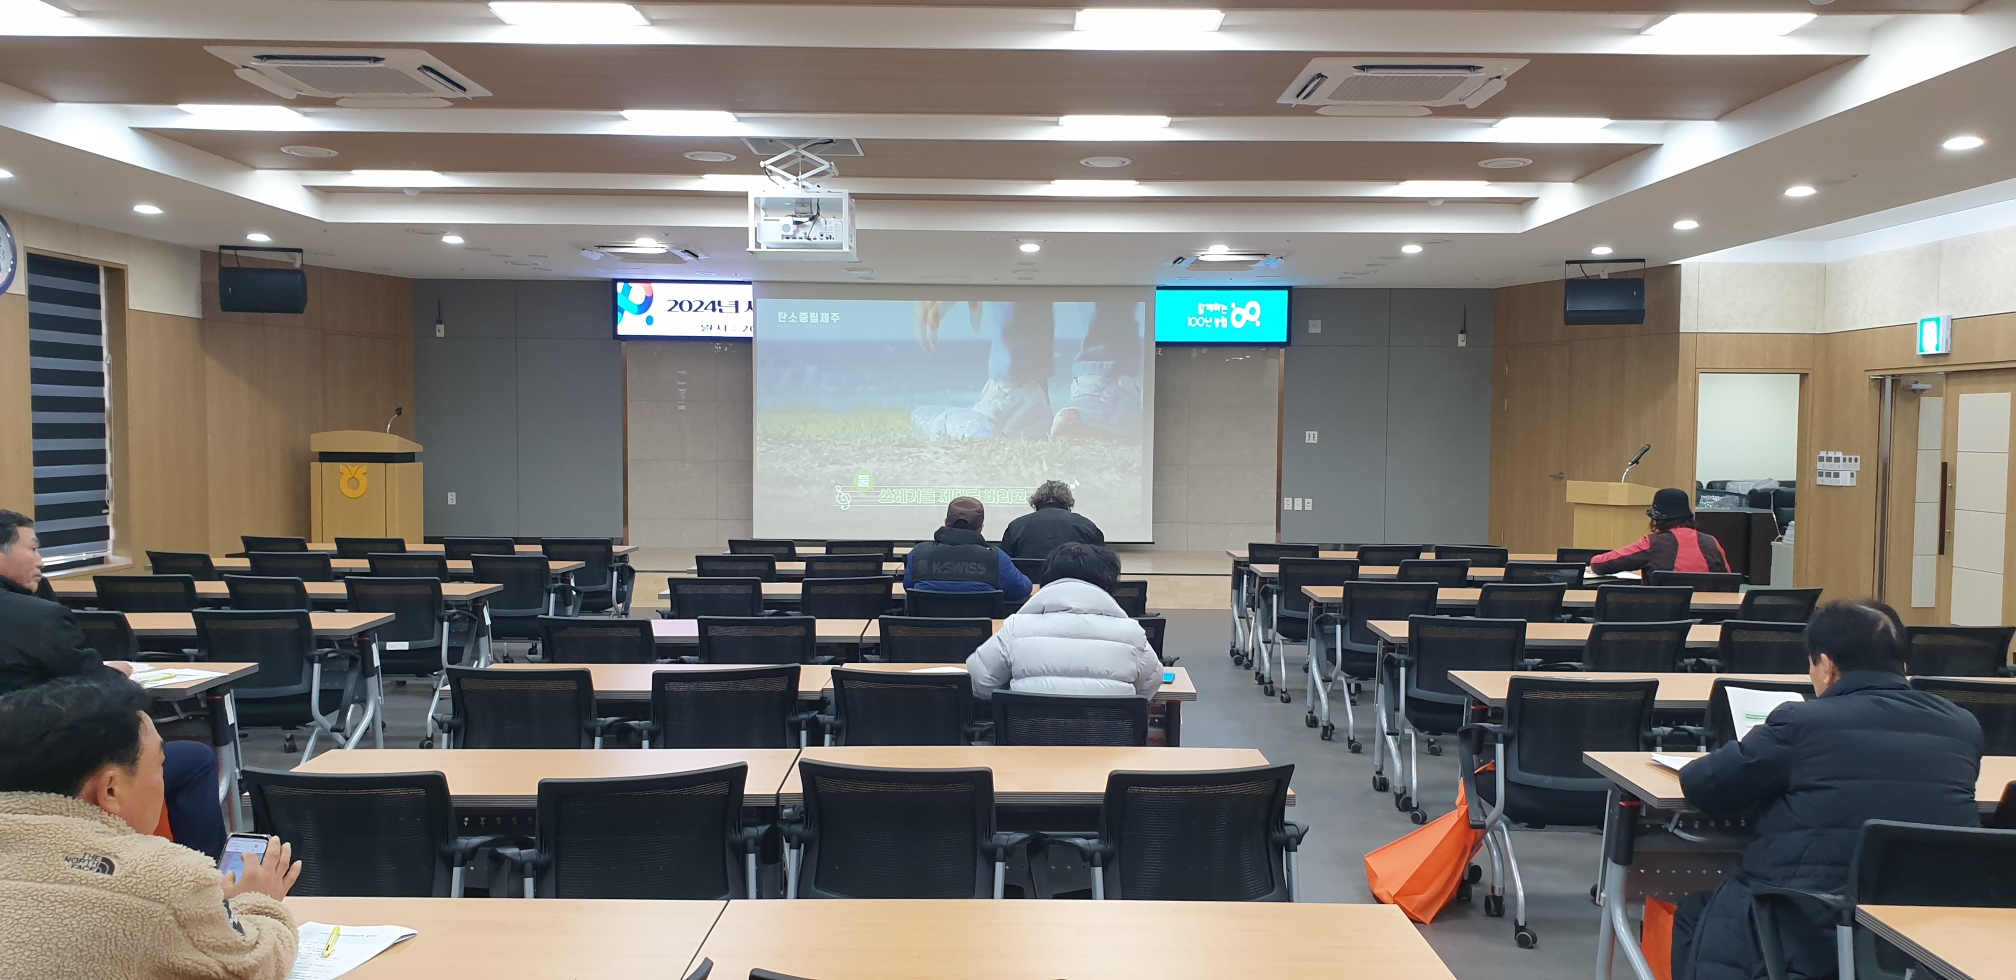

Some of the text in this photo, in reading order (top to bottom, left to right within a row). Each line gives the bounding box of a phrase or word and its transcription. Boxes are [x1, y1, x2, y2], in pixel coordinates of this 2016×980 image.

[666, 299, 739, 314] 2024년
[878, 488, 935, 504] 쓰레기를
[984, 488, 1027, 504] 버리고
[64, 856, 100, 867] NORTH
[82, 852, 102, 861] THE
